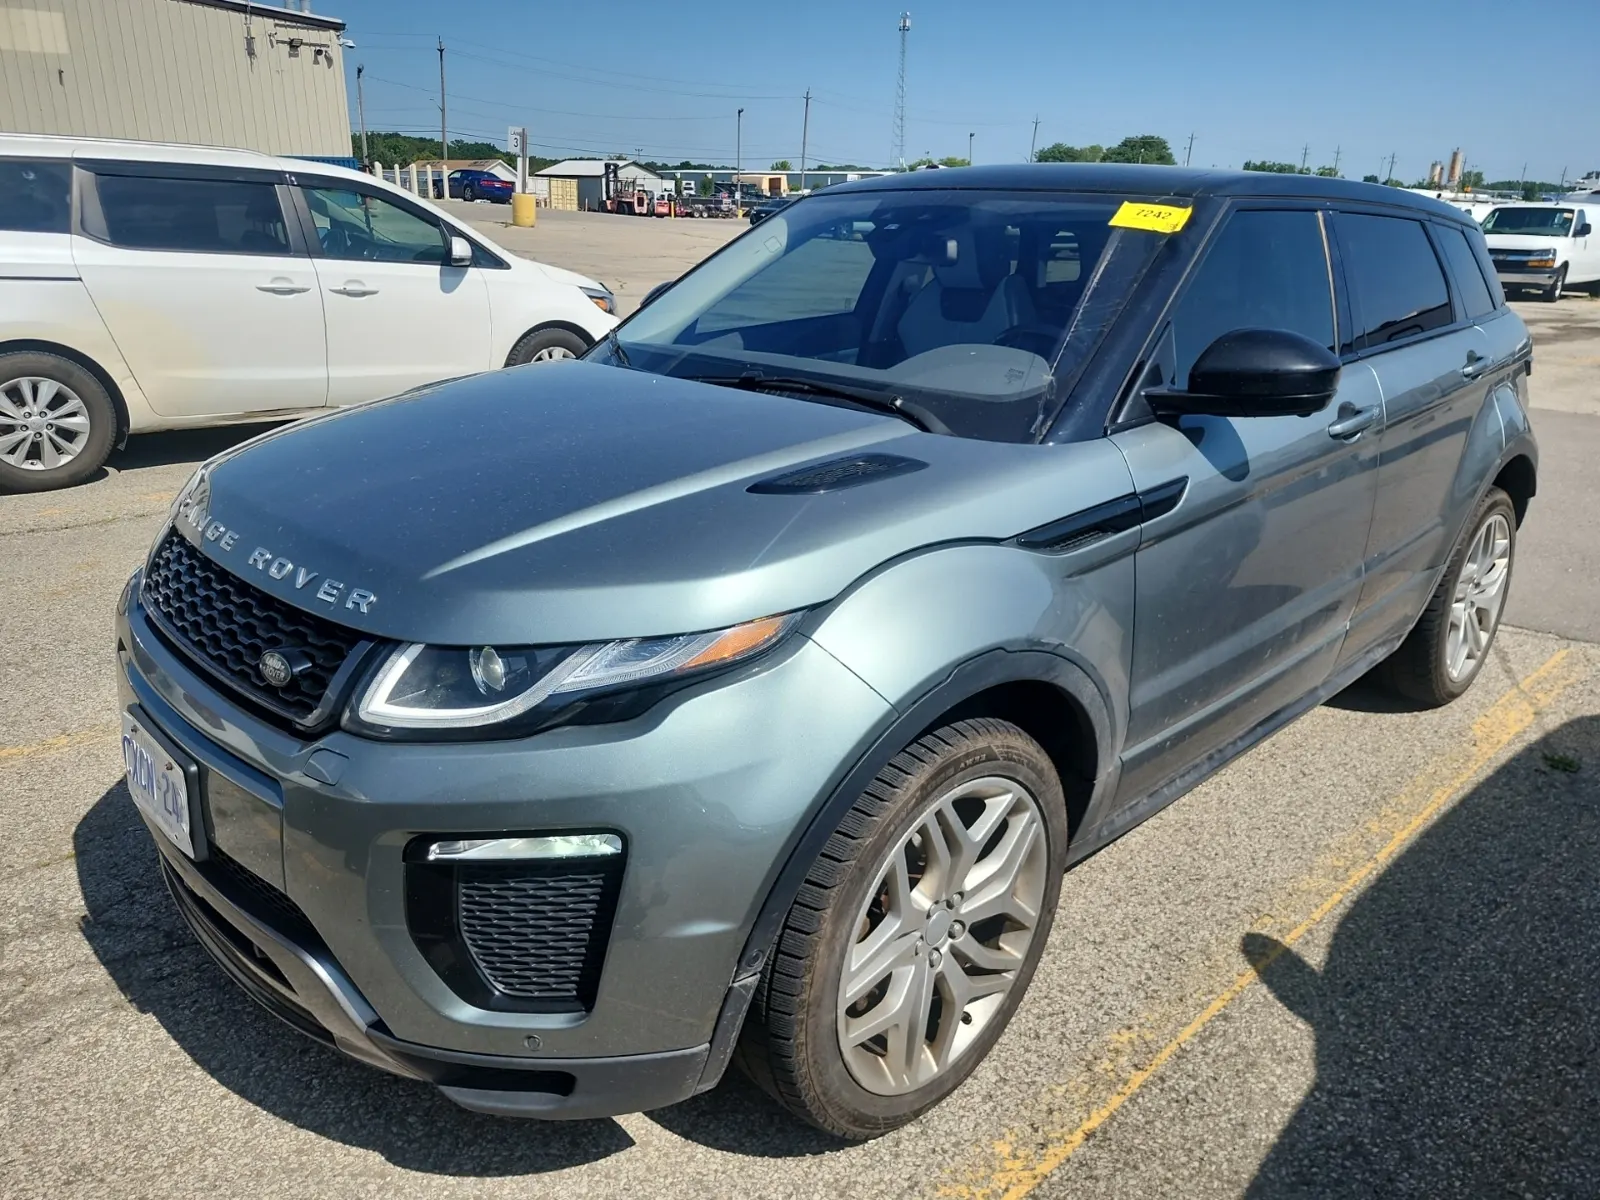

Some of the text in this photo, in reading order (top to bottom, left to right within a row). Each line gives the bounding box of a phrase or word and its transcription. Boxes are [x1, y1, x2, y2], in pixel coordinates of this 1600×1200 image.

[513, 137, 519, 148] 3
[1136, 208, 1172, 220] 7242
[248, 546, 377, 614] ROVER
[265, 656, 282, 670] LAND
[122, 735, 158, 801] CXCN
